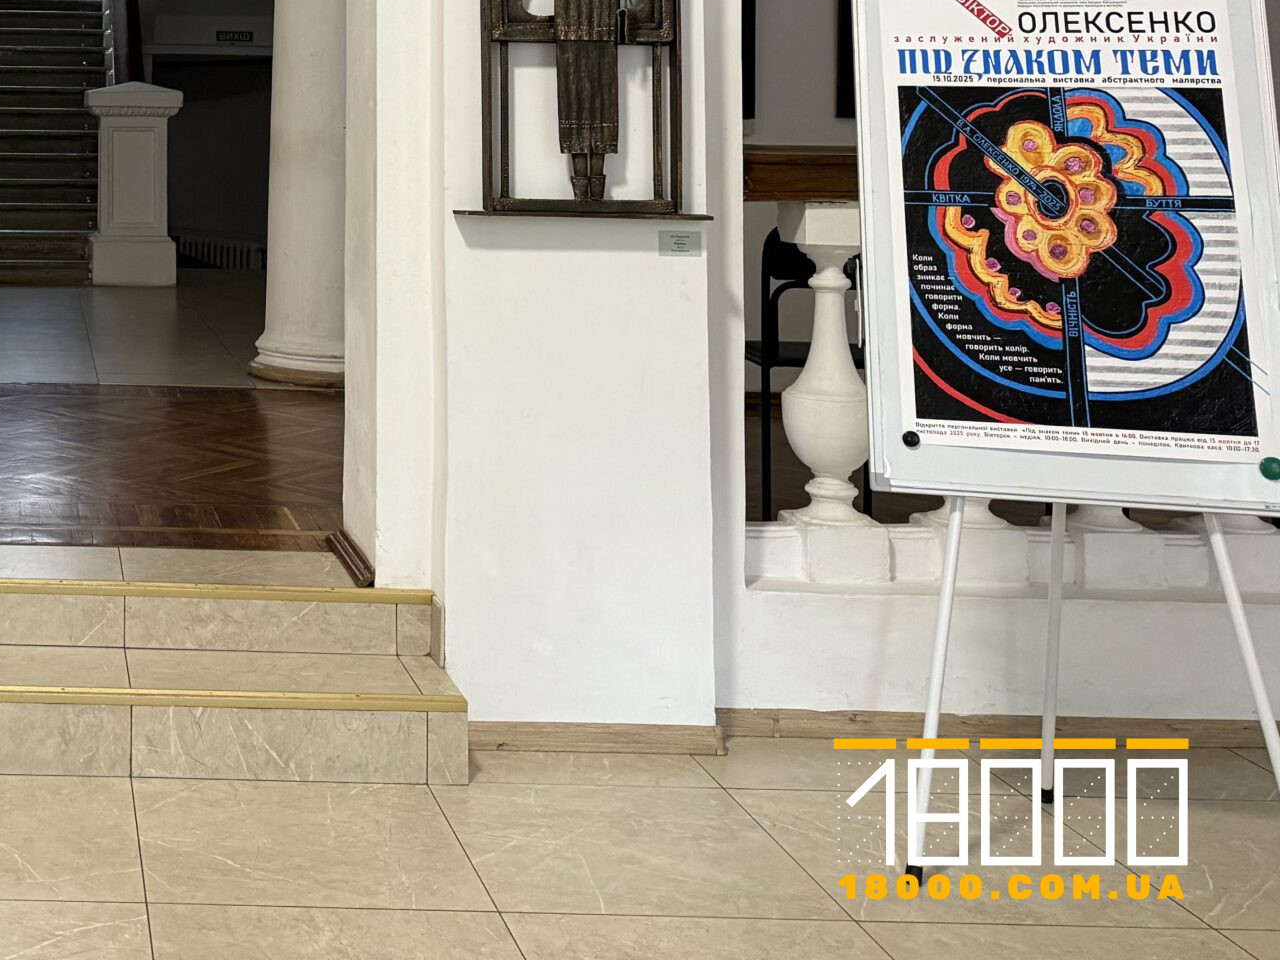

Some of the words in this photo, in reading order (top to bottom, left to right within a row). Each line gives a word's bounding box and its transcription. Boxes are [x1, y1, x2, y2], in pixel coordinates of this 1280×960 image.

[1018, 10, 1216, 34] ОЛЕКСЕНКО
[894, 34, 1014, 44] заслужений
[1024, 35, 1124, 44] художник
[1132, 34, 1218, 44] України
[897, 48, 952, 74] ПІД
[961, 49, 1102, 81] ЗНАКОМ
[1112, 49, 1220, 76] ТЕМИ
[956, 119, 972, 135] В.А.
[973, 134, 1020, 176] ОЛЕКСЕНКО
[932, 193, 970, 203] КВІТКА
[1146, 199, 1182, 208] БУТТЯ
[1068, 291, 1079, 337] ВІЧНІСТЬ
[946, 323, 973, 331] форма
[1005, 344, 1030, 353] колір.
[1029, 375, 1064, 384] пам'ять.
